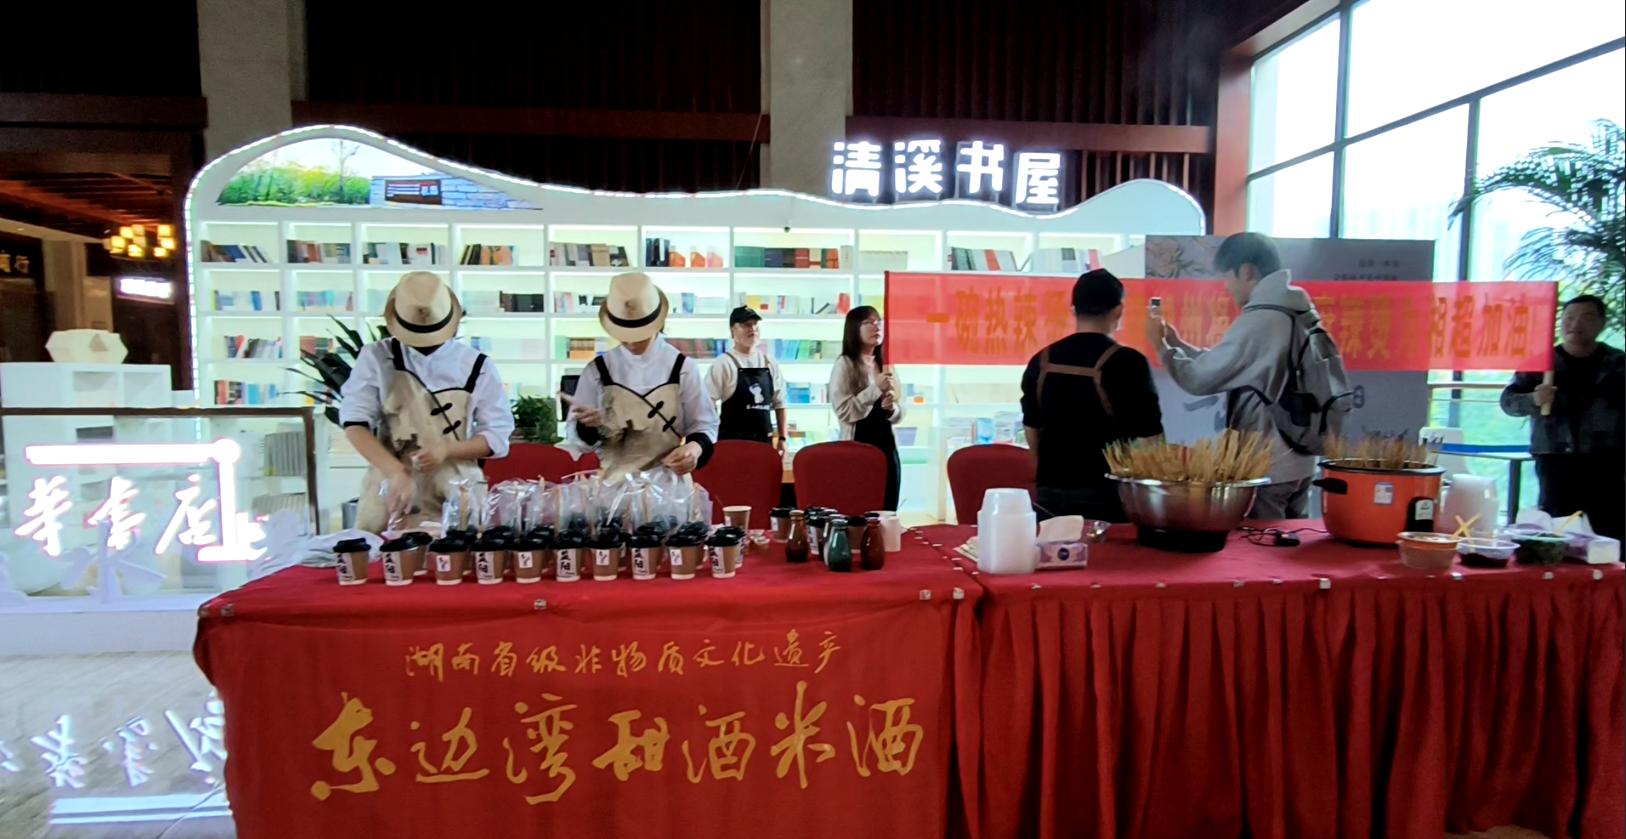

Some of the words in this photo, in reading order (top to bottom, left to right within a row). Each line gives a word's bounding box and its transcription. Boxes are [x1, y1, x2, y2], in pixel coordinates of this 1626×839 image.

[831, 139, 1061, 204] 清溪书屋
[405, 629, 841, 682] 湖南省级非物质文化遗产
[311, 680, 925, 805] 东边湾甜酒米酒
